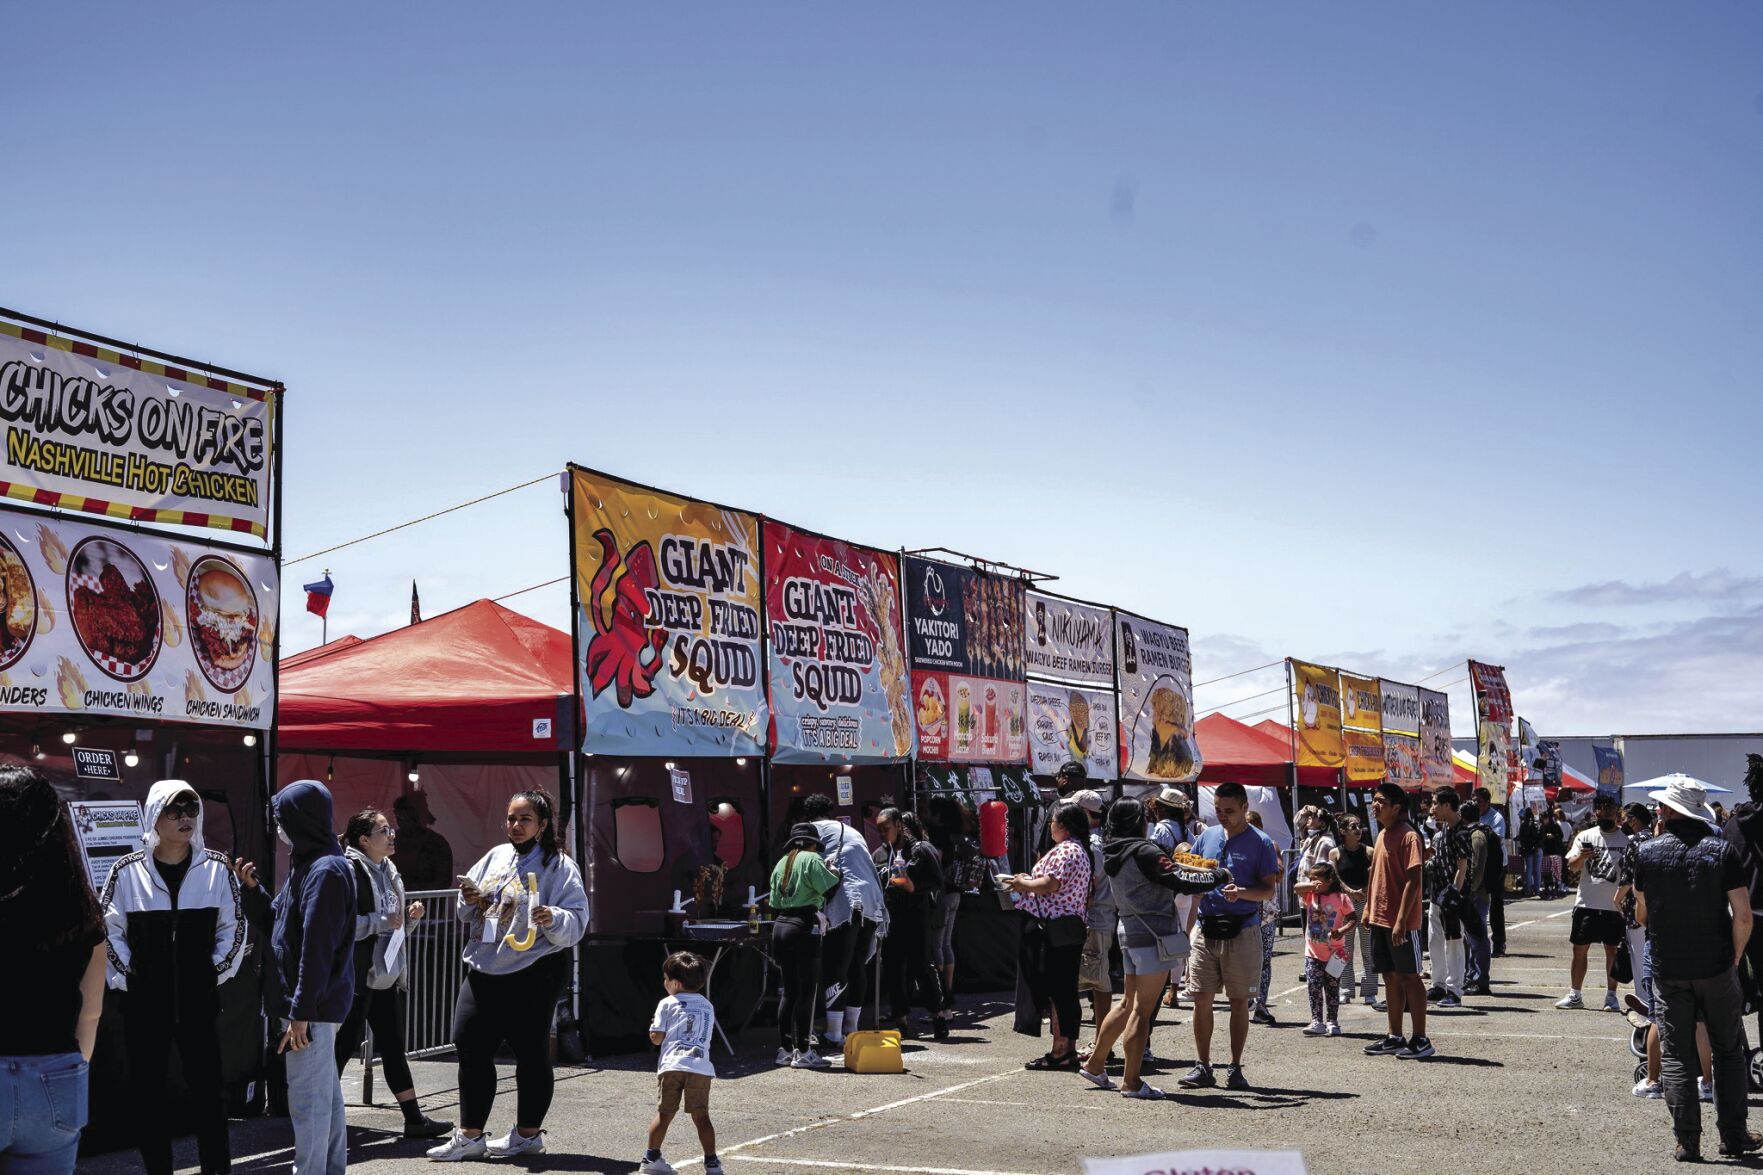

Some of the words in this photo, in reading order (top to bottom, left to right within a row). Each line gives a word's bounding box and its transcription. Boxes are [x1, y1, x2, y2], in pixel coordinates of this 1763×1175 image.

[0, 361, 135, 446] CHICKS
[138, 398, 193, 458] ON
[195, 407, 263, 475] FIRE
[8, 426, 124, 486] NASHVILLE
[125, 452, 170, 494] HOT
[170, 463, 258, 507] CHICKEN
[660, 536, 748, 594] GIANT
[821, 555, 833, 572] ON
[834, 561, 841, 577] A
[784, 580, 856, 628] GIANT
[646, 591, 700, 629] DEEP
[708, 599, 758, 640] FRIED
[914, 617, 959, 639] YAKITORI
[1053, 614, 1103, 651] NIKUYAMA
[773, 622, 819, 657] DEEP
[823, 630, 873, 666] FRIED
[925, 638, 952, 657] YADO
[1141, 629, 1169, 649] WAGYU
[1169, 636, 1185, 653] BEEF
[669, 635, 756, 694] SQUID
[1026, 650, 1050, 667] WAGYU
[1053, 655, 1067, 670] BEEF
[1069, 658, 1091, 673] RAMEN
[1140, 648, 1168, 668] RAMEN
[0, 687, 47, 707] NDERS
[793, 661, 862, 711] SQUID
[85, 691, 132, 709] CHICKEN
[133, 693, 164, 713] WINGS
[186, 700, 222, 718] CHICKEN
[222, 704, 260, 721] SANDWICH
[701, 710, 717, 725] BIG
[719, 711, 745, 728] DEAL
[820, 730, 825, 746] A
[826, 730, 838, 747] BIG
[840, 730, 857, 748] DEAL
[78, 752, 112, 765] ORDER
[87, 765, 109, 775] HERE
